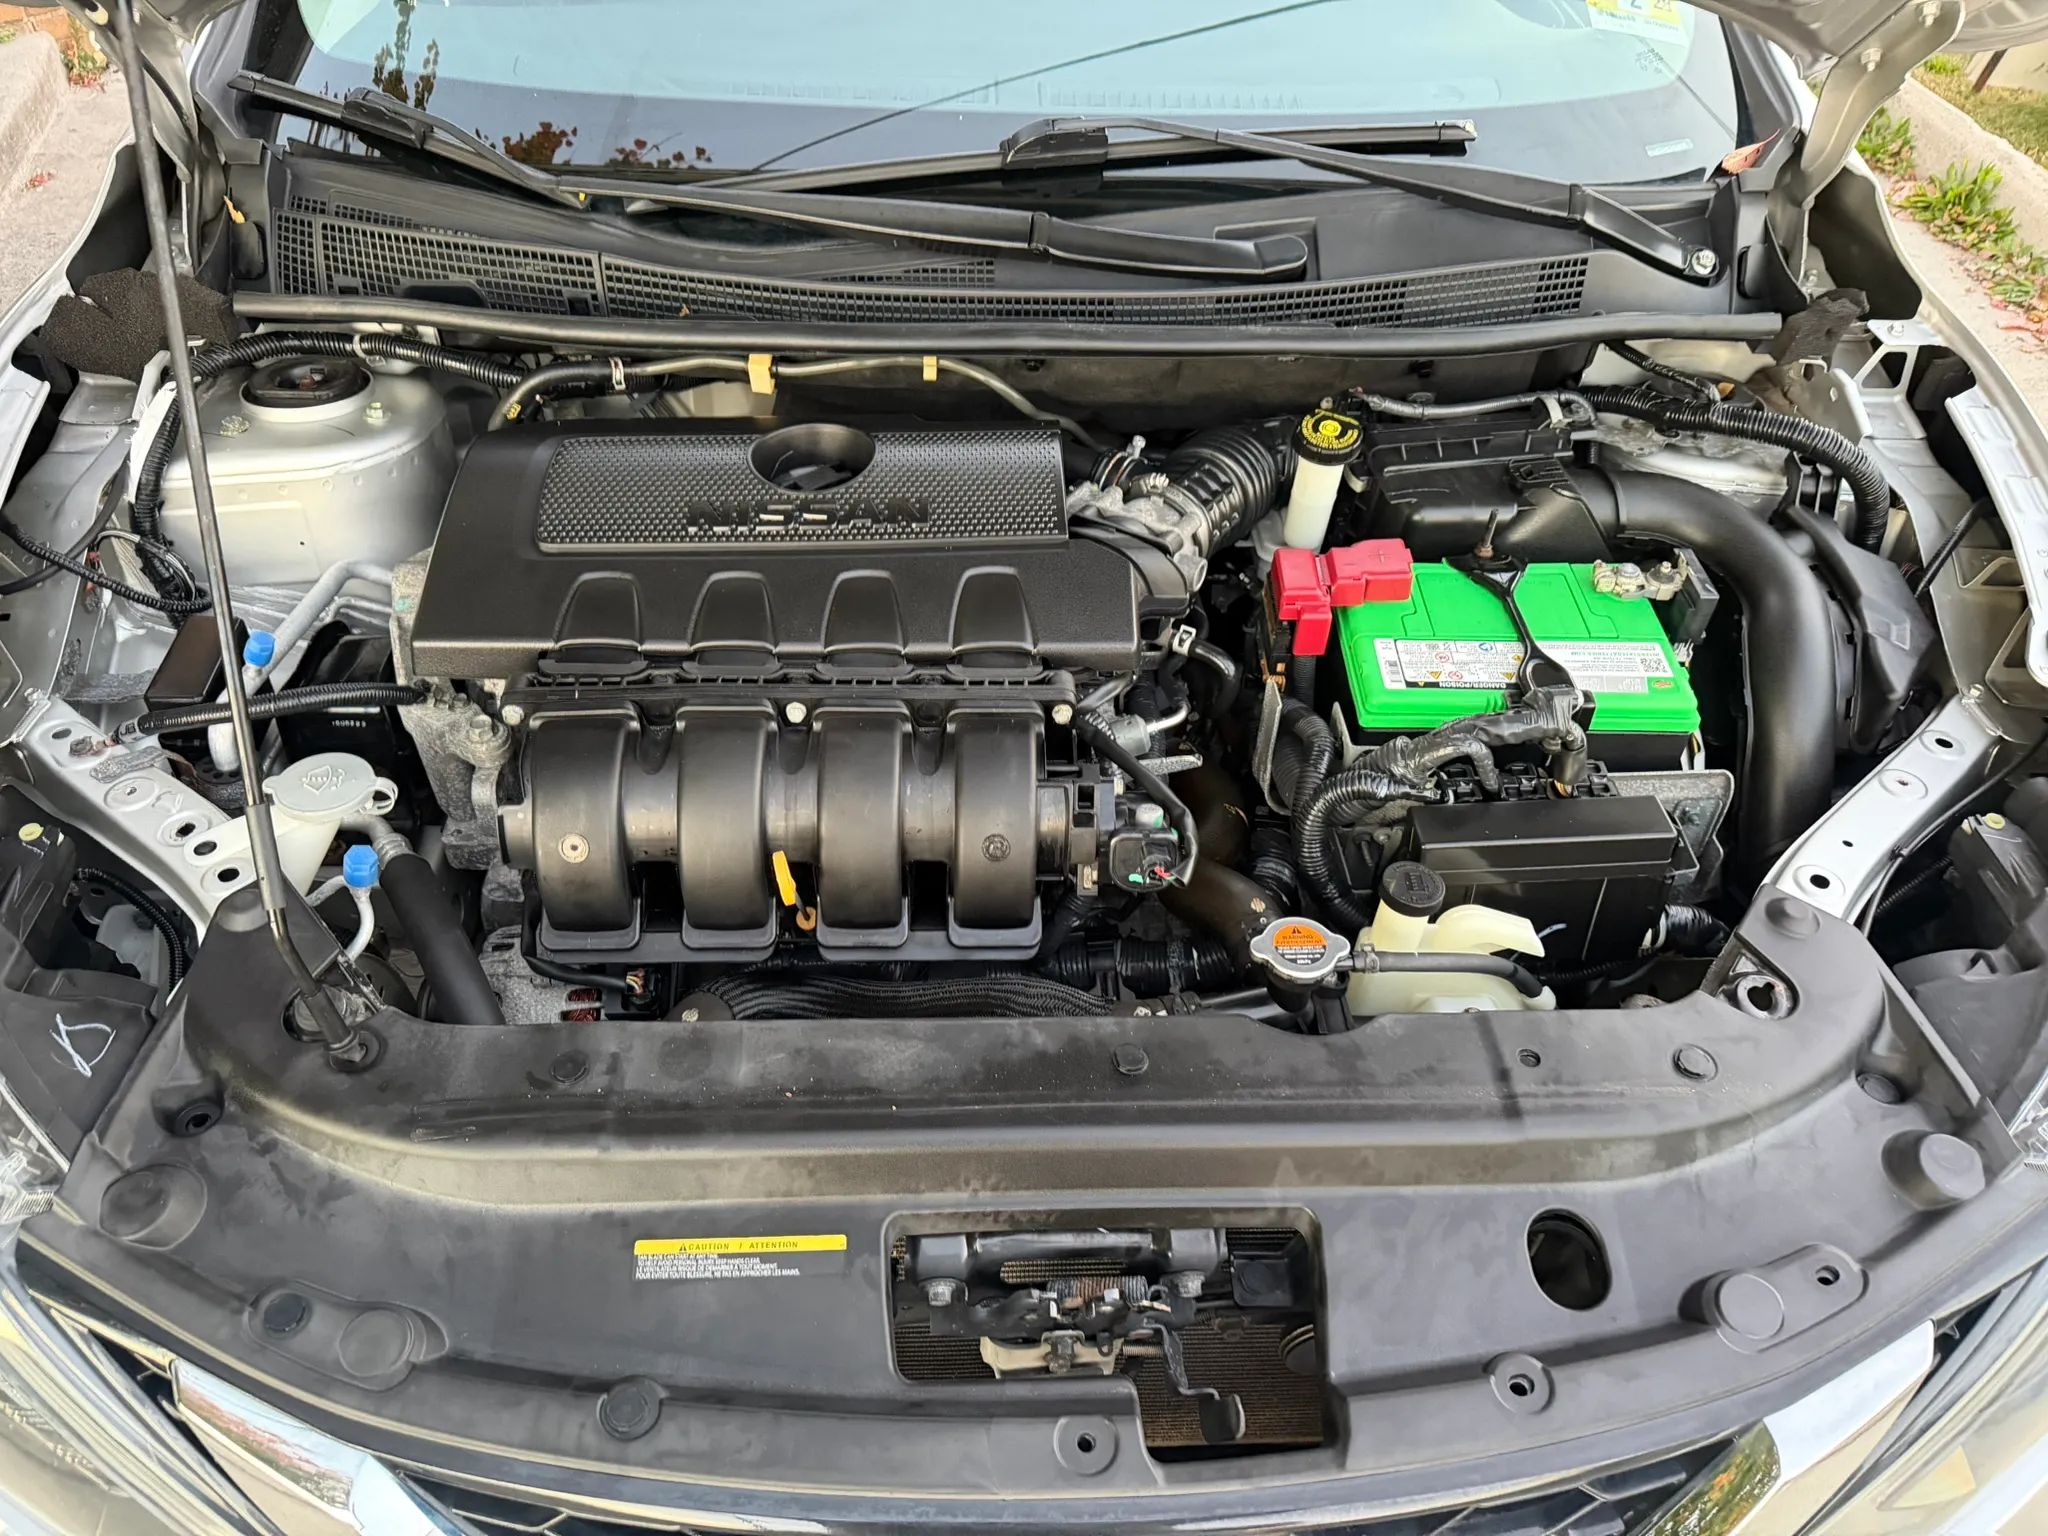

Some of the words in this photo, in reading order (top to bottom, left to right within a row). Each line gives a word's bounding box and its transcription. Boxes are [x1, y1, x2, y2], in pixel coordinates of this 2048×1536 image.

[687, 500, 930, 533] NISSAN
[1438, 680, 1507, 689] DANGER/POISON
[688, 1242, 730, 1251] CAUTION
[749, 1241, 799, 1250] ATTENTION
